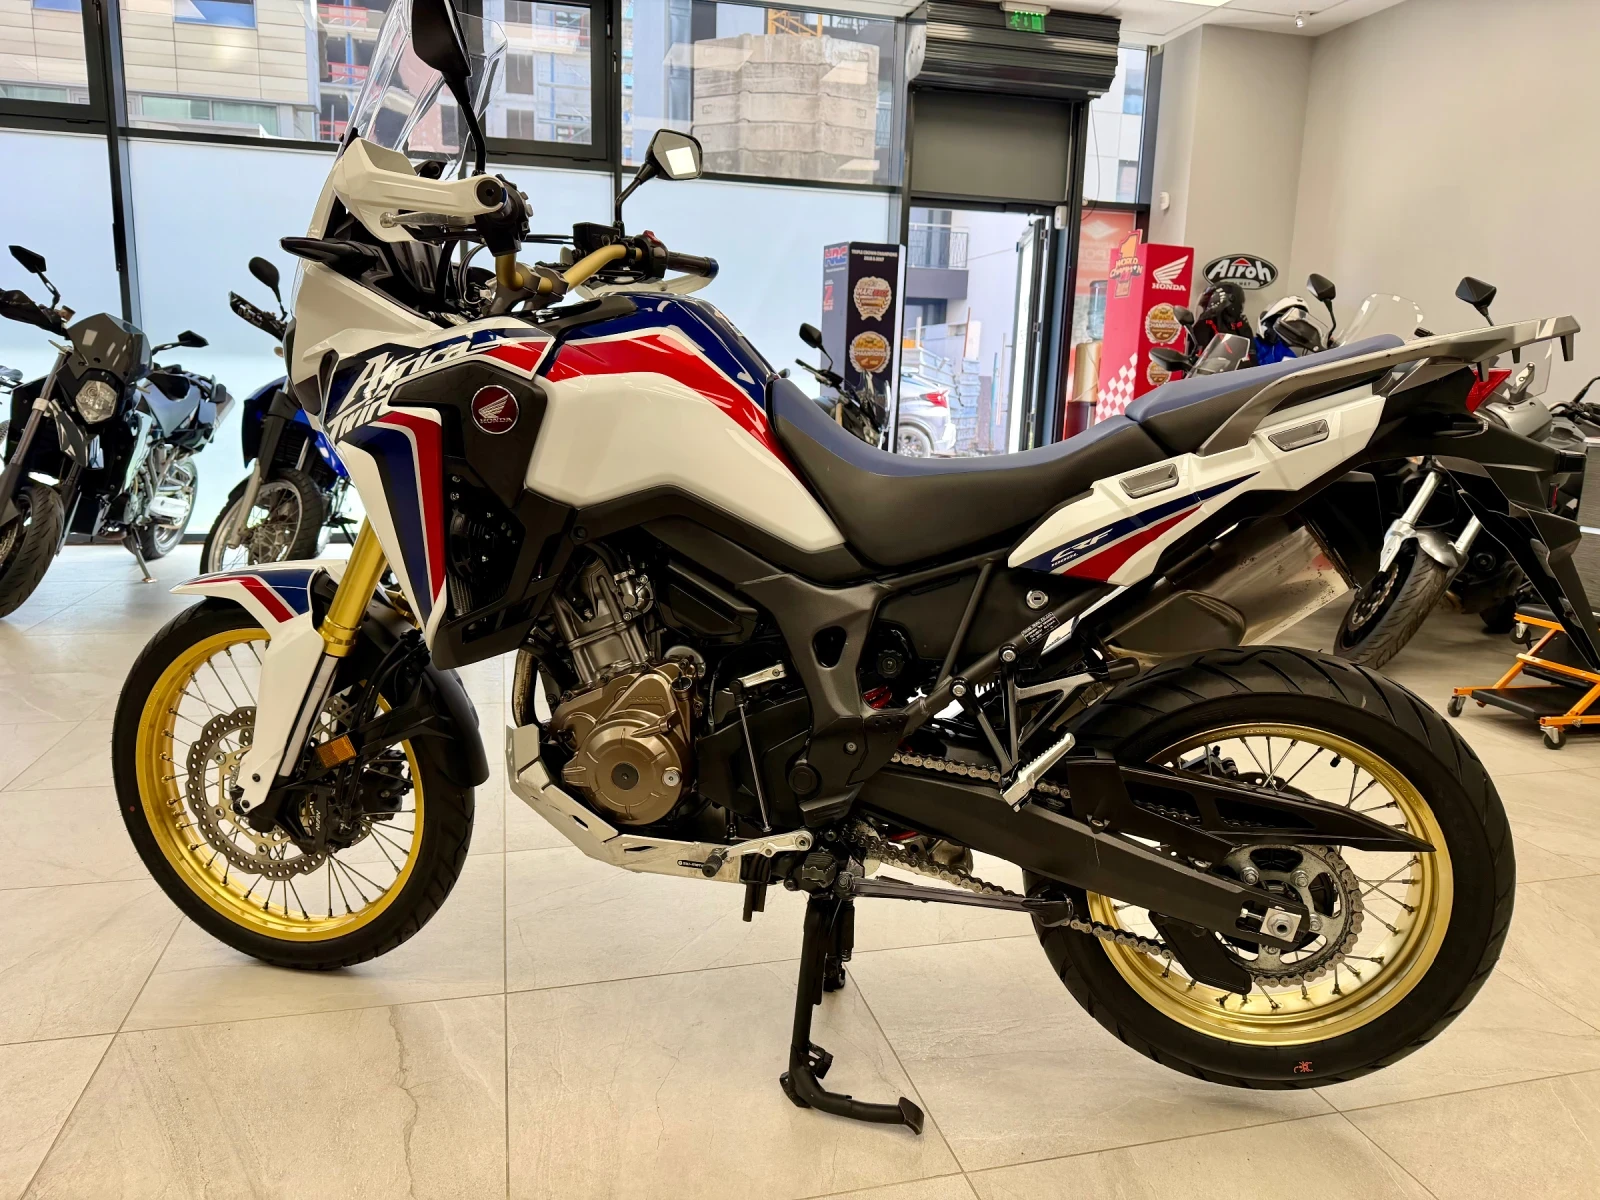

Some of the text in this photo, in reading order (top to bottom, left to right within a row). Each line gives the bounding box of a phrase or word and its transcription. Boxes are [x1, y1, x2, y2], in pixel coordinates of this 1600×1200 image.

[1115, 257, 1138, 267] WORLD
[1207, 259, 1271, 282] Airoh
[1152, 282, 1186, 291] HONDA
[336, 339, 502, 415] Africa
[1051, 528, 1113, 562] CRF
